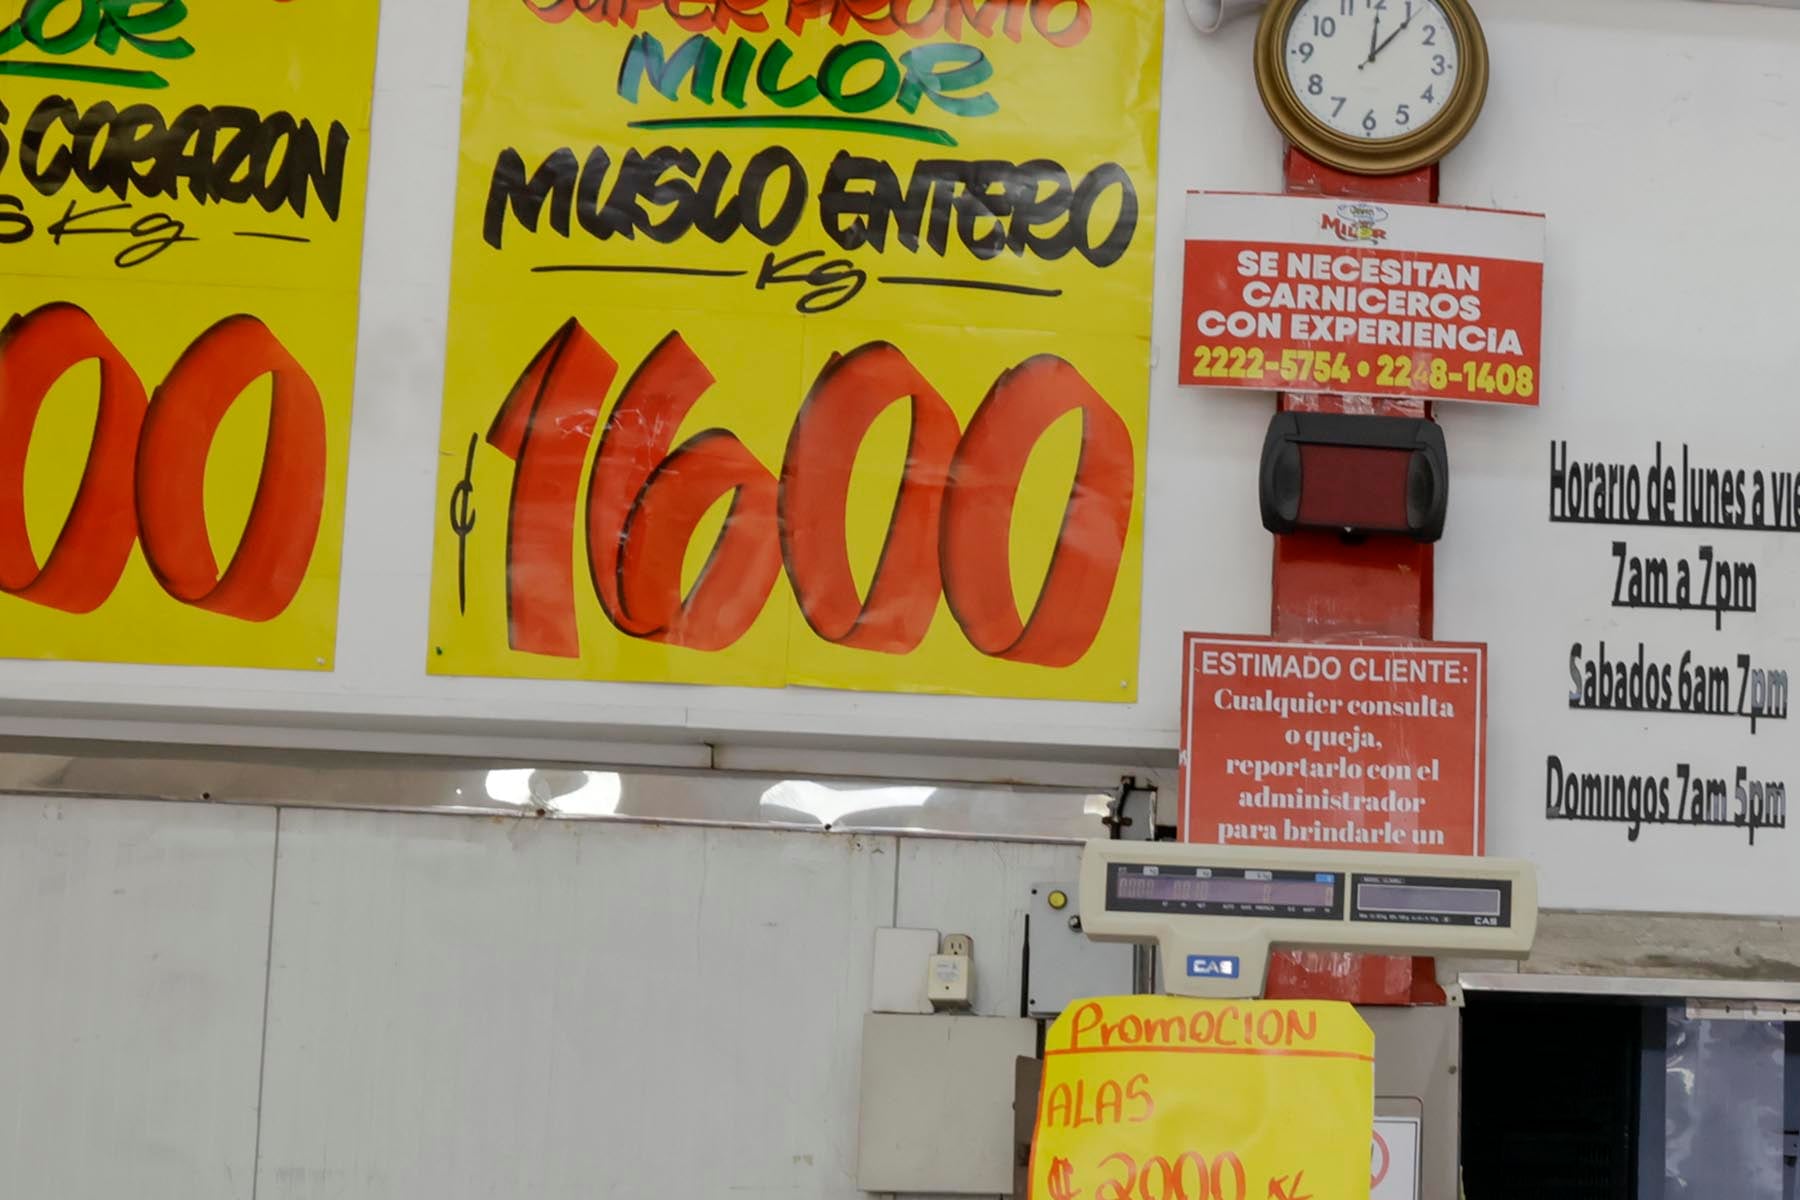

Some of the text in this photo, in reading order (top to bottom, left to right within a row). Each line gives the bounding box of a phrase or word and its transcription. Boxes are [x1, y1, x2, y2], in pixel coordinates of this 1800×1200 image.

[1313, 16, 1336, 38] 10
[1421, 25, 1436, 46] 2
[1298, 42, 1314, 63] 9
[1431, 54, 1446, 76] 3
[616, 32, 999, 117] MILOR
[1307, 74, 1324, 96] 8
[1330, 97, 1347, 118] 7
[1420, 84, 1435, 104] 4
[1362, 109, 1377, 131] 6
[1395, 104, 1410, 125] 5
[19, 95, 349, 222] CORAZON
[483, 145, 1139, 267] MUSLO ENTERO
[1237, 250, 1480, 291] SE NECESITAN
[1243, 281, 1481, 321] CARNICEROS
[1197, 310, 1522, 356] CON EXPERIENCIA
[1192, 345, 1534, 397] 2222-5754 2248-1408
[1550, 440, 1641, 521] Horario
[1647, 440, 1676, 522] de
[1683, 443, 1746, 526] lunes
[1752, 469, 1766, 527] a
[1612, 541, 1756, 631] 7am a 7pm
[1202, 651, 1468, 684] ESTIMADO CLIENTE:
[1569, 641, 1788, 734] Sabados 6am 7pm
[1214, 688, 1454, 719] Cualquier consulta
[1285, 726, 1383, 752] o queja,
[1226, 756, 1439, 781] reportarlo con el
[1239, 786, 1426, 813] administrador
[1546, 755, 1786, 846] Domingos 7am 5pm
[1218, 819, 1445, 846] para brindarle un
[1193, 959, 1233, 975] CAS
[1047, 1073, 1155, 1128] ALAS
